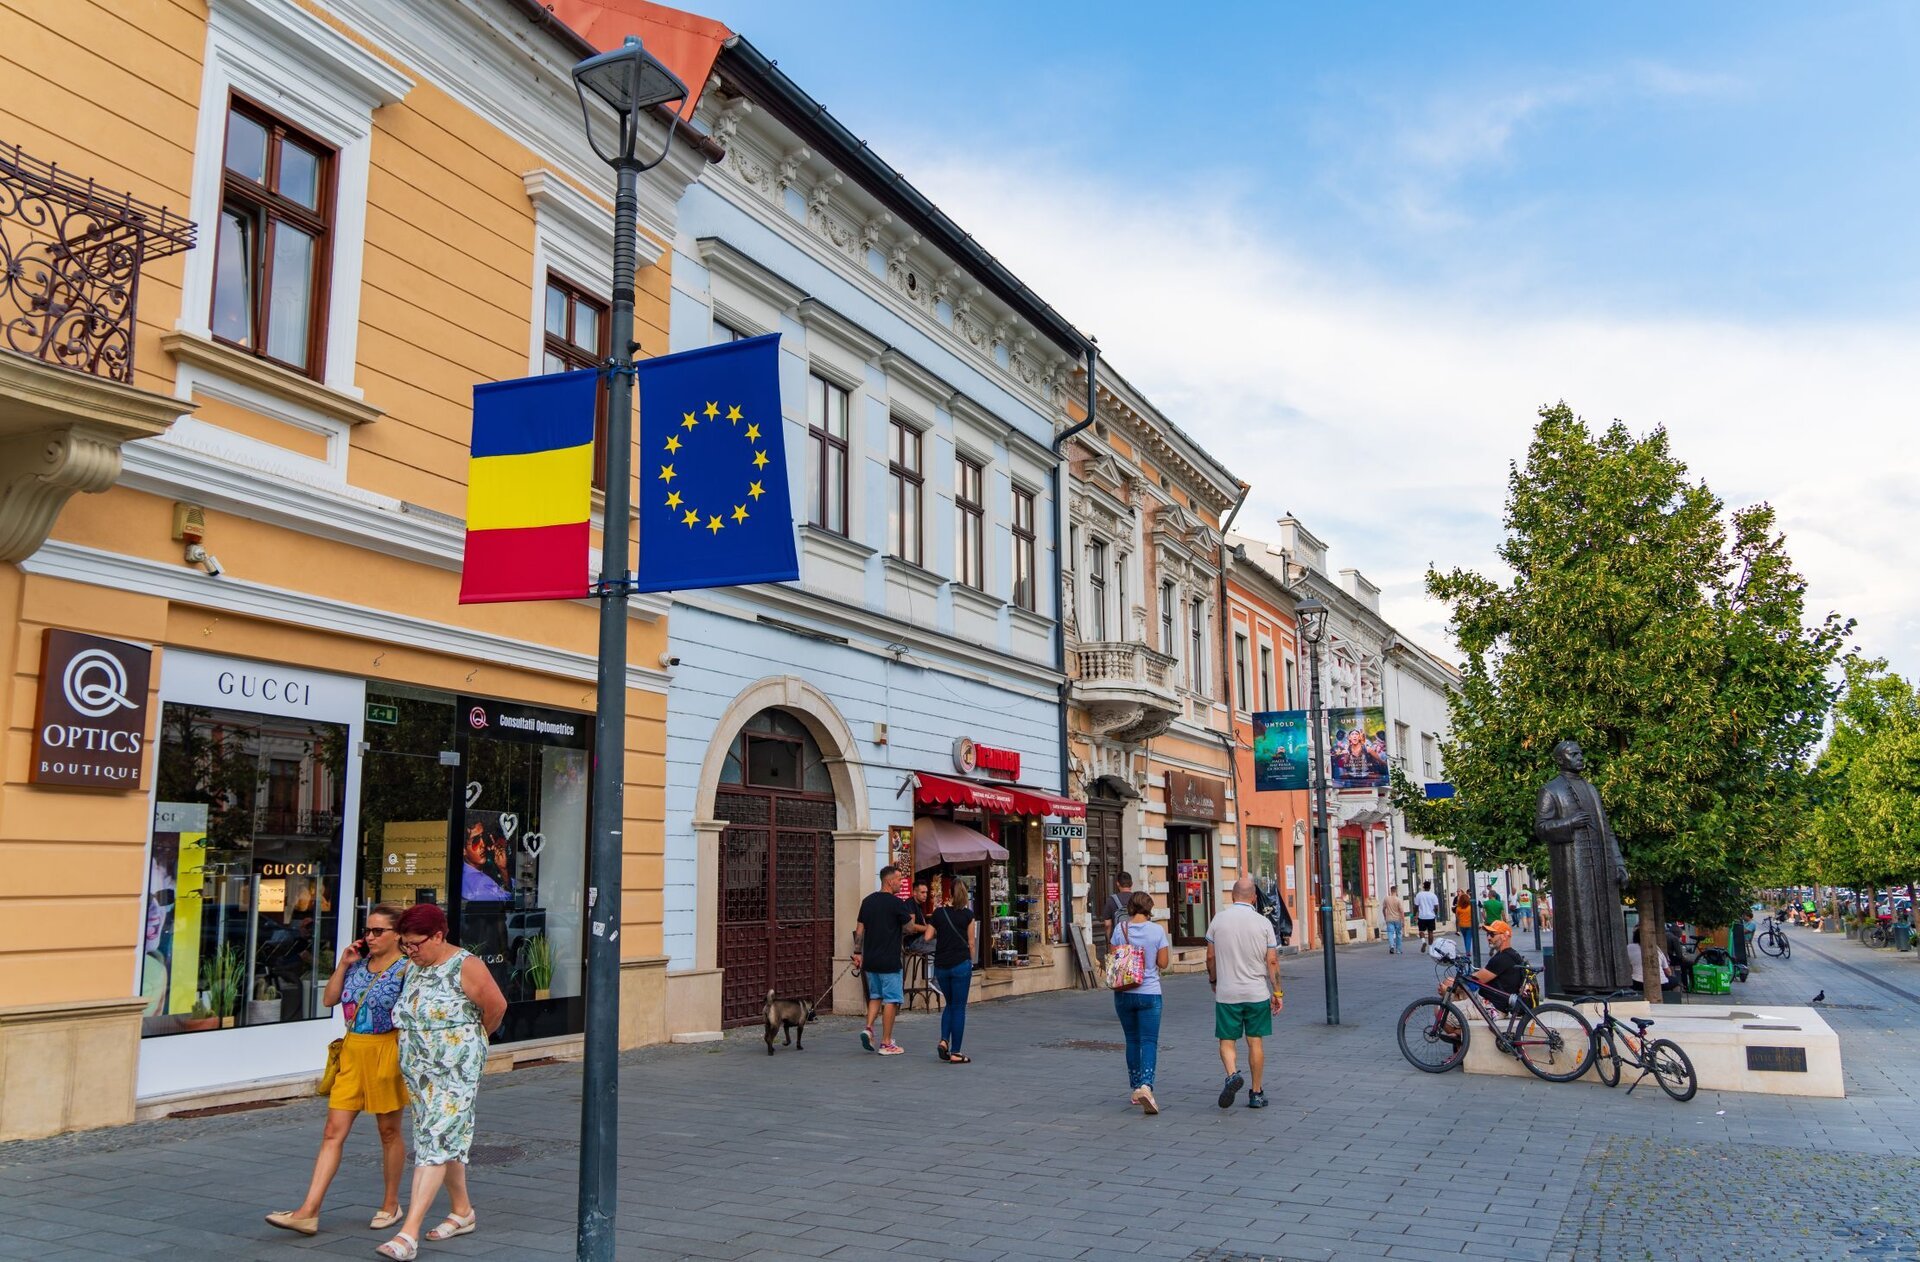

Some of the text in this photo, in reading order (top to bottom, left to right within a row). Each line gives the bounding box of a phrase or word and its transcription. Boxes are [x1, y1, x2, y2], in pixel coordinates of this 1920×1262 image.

[218, 671, 309, 706] GUCCI
[536, 720, 575, 736] Optometrice
[43, 723, 141, 754] OPTICS
[41, 761, 139, 780] BOUTIQUE
[263, 863, 313, 876] GUCCI
